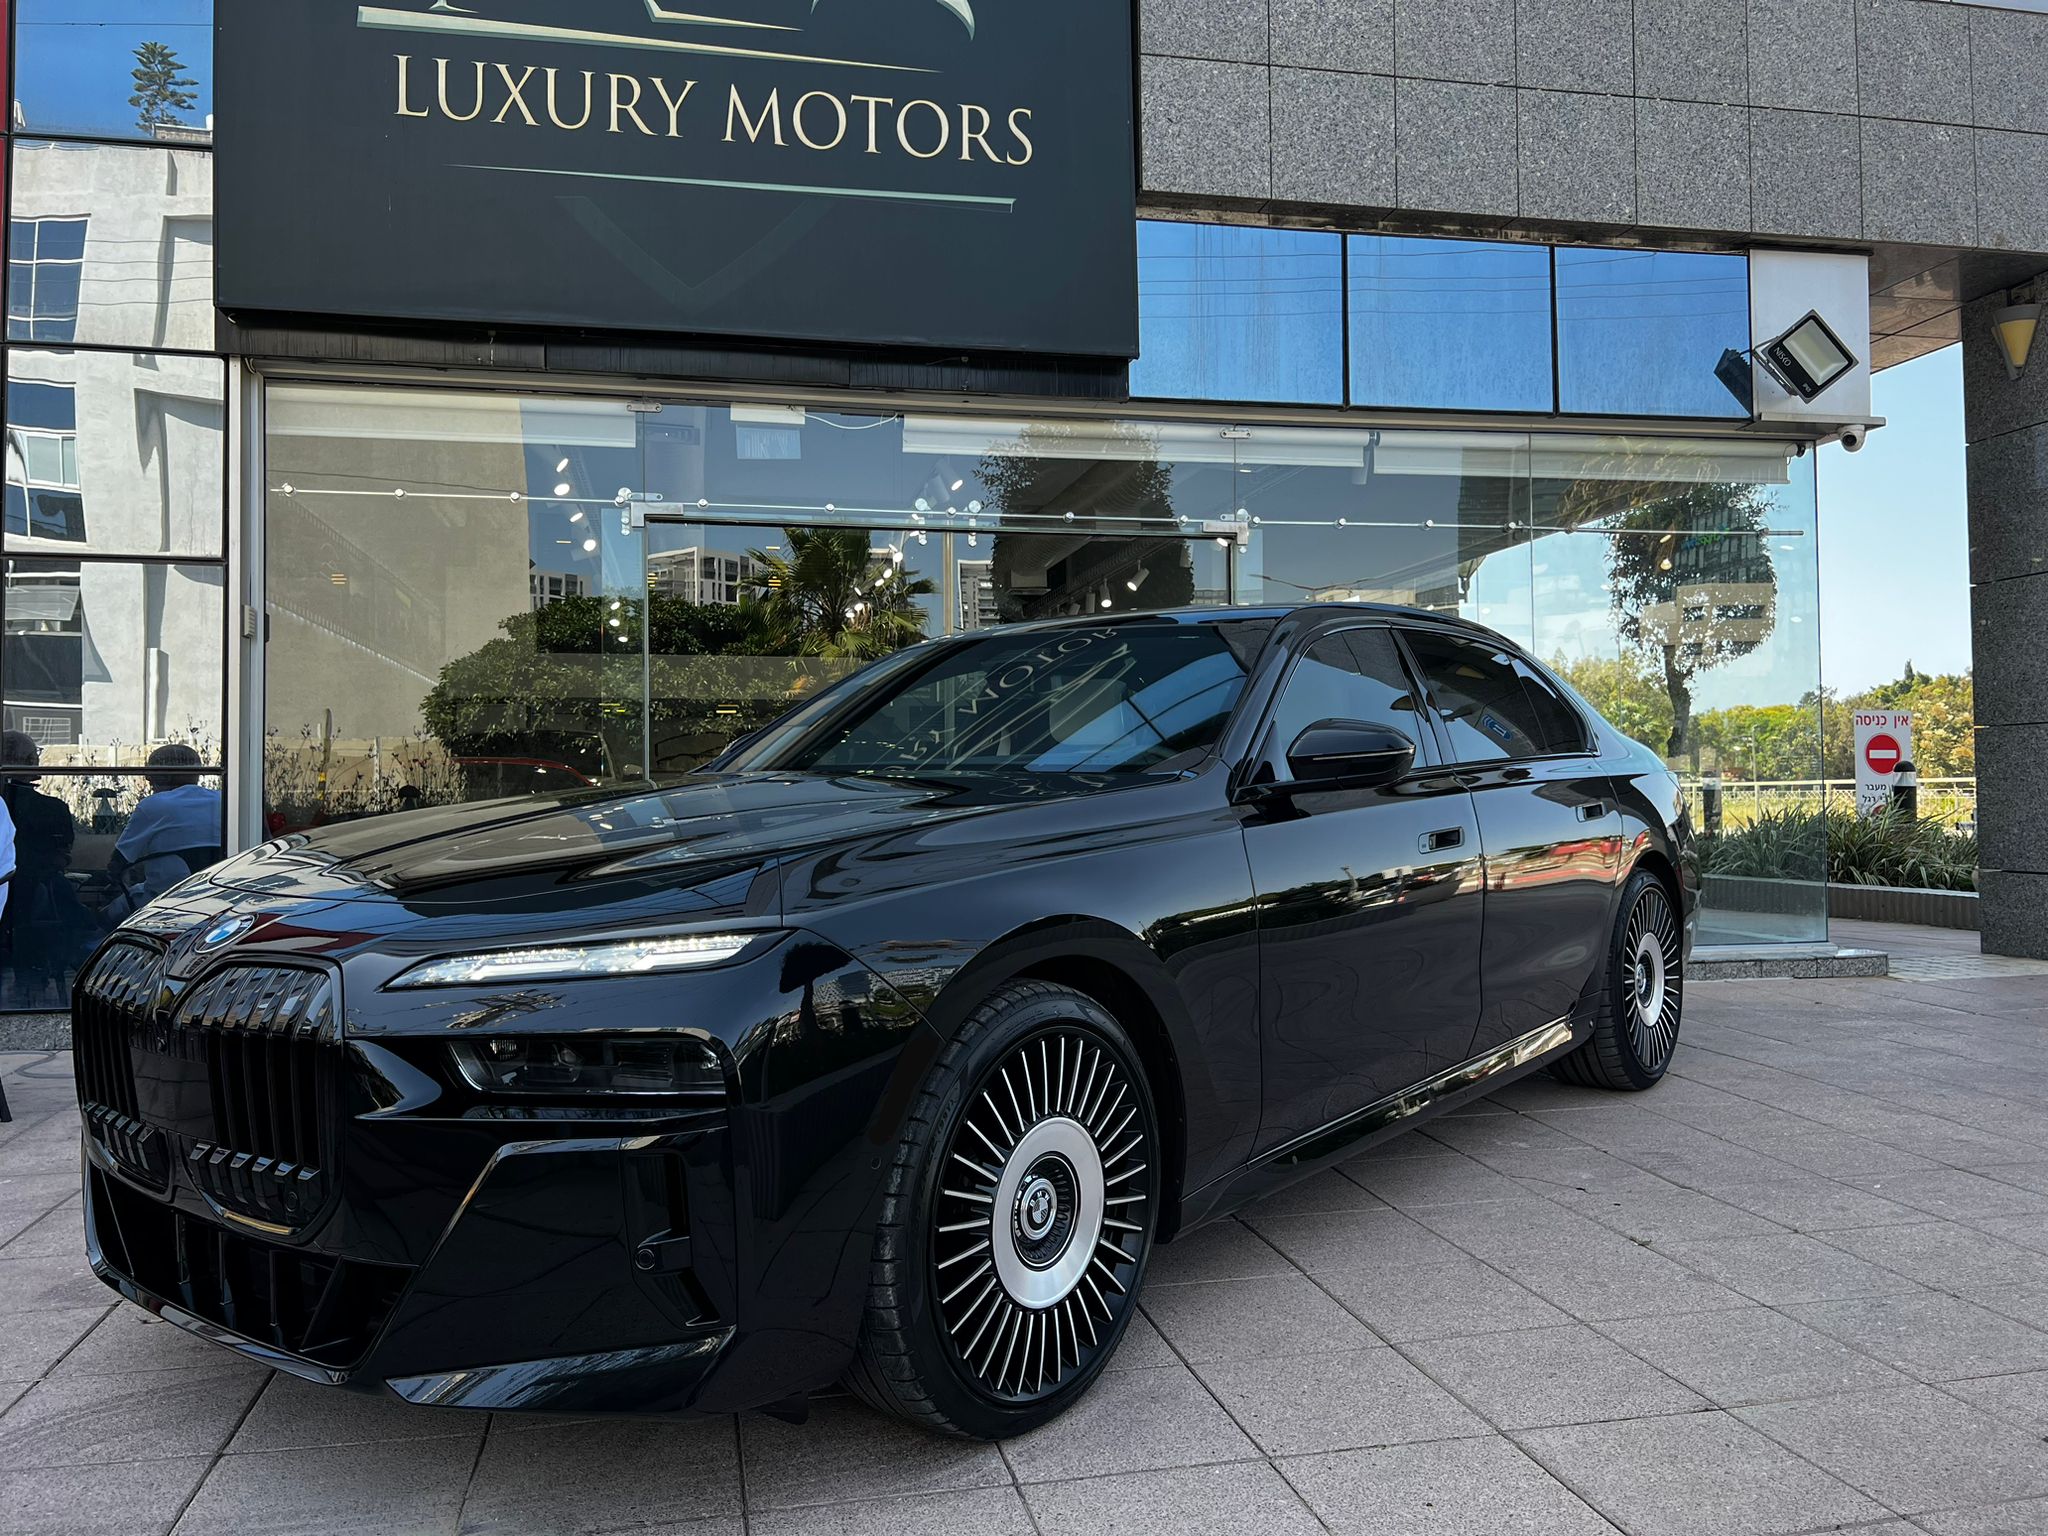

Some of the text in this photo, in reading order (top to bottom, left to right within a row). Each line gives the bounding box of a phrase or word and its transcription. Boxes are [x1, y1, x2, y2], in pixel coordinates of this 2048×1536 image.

[394, 54, 1034, 166] LUXURY MOTORS
[1773, 346, 1791, 367] NISCO
[1855, 715, 1909, 729] אין כניסה
[1865, 784, 1887, 792] מעבר
